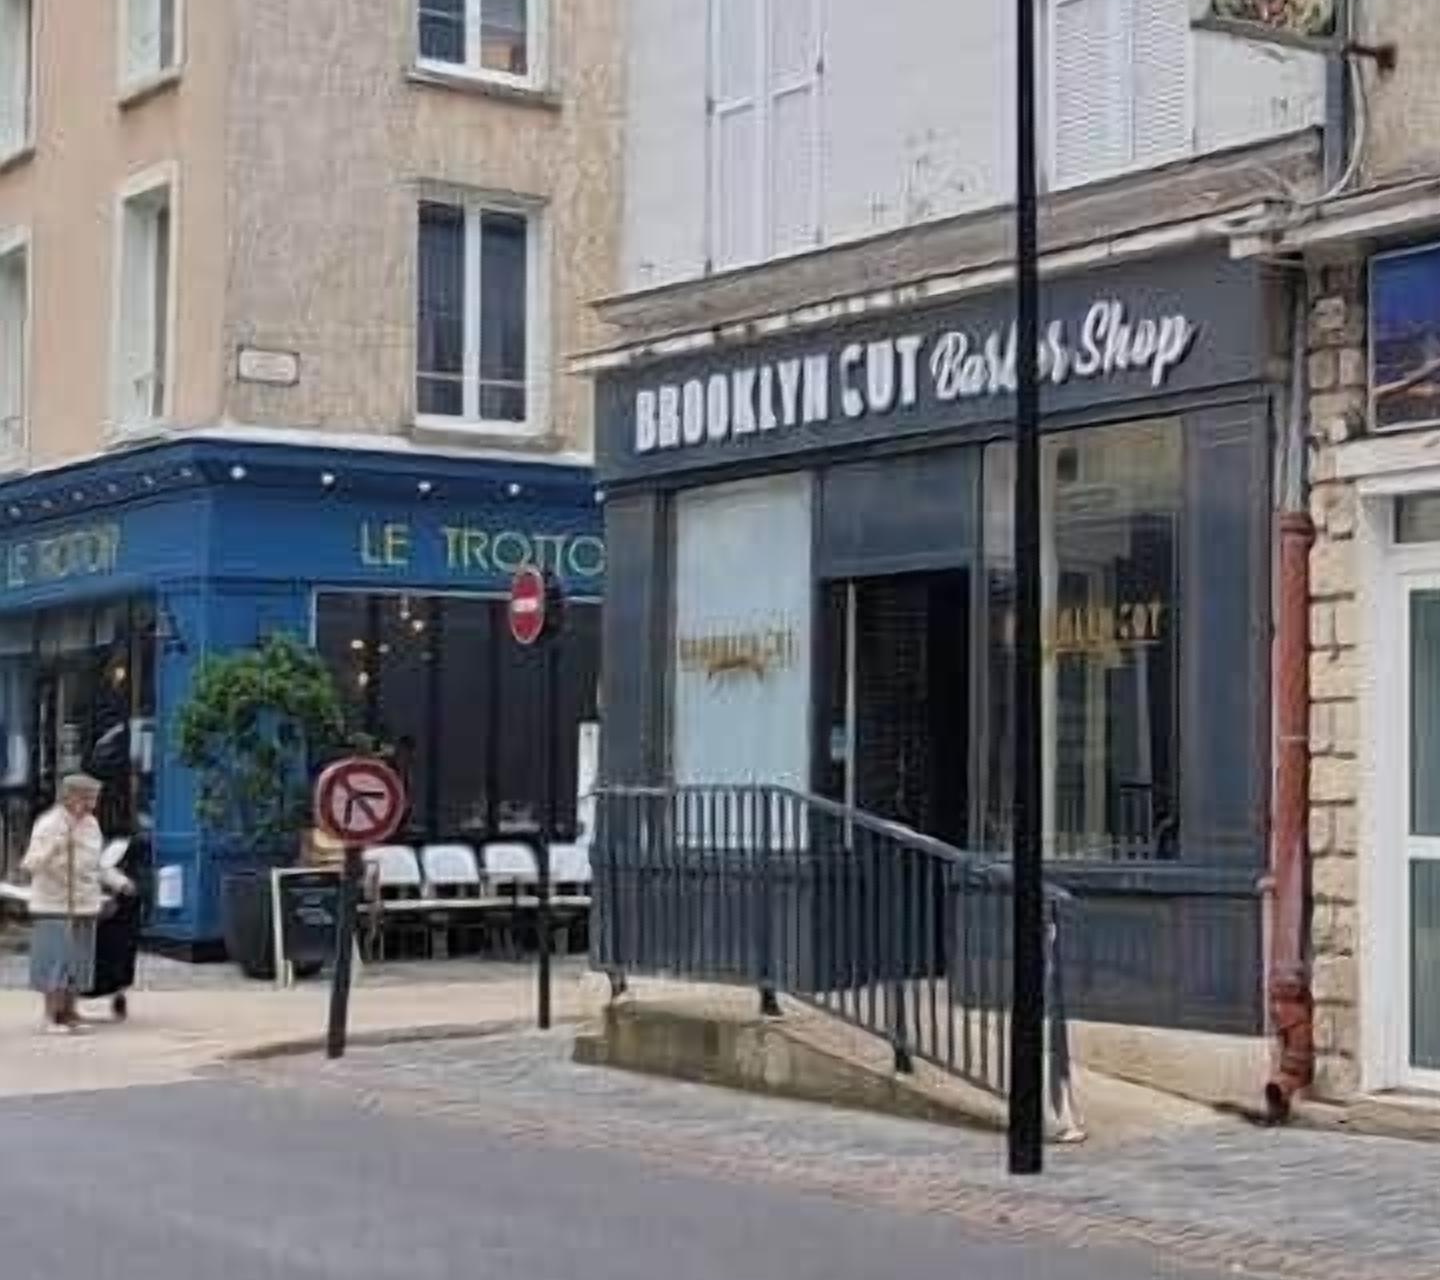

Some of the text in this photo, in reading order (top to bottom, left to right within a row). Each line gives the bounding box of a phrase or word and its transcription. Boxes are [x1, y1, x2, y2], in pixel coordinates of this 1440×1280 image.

[634, 354, 830, 452] BROOKLYN
[839, 334, 922, 417] CUT
[1074, 300, 1192, 386] Shop
[360, 522, 605, 577] LE TROTTO
